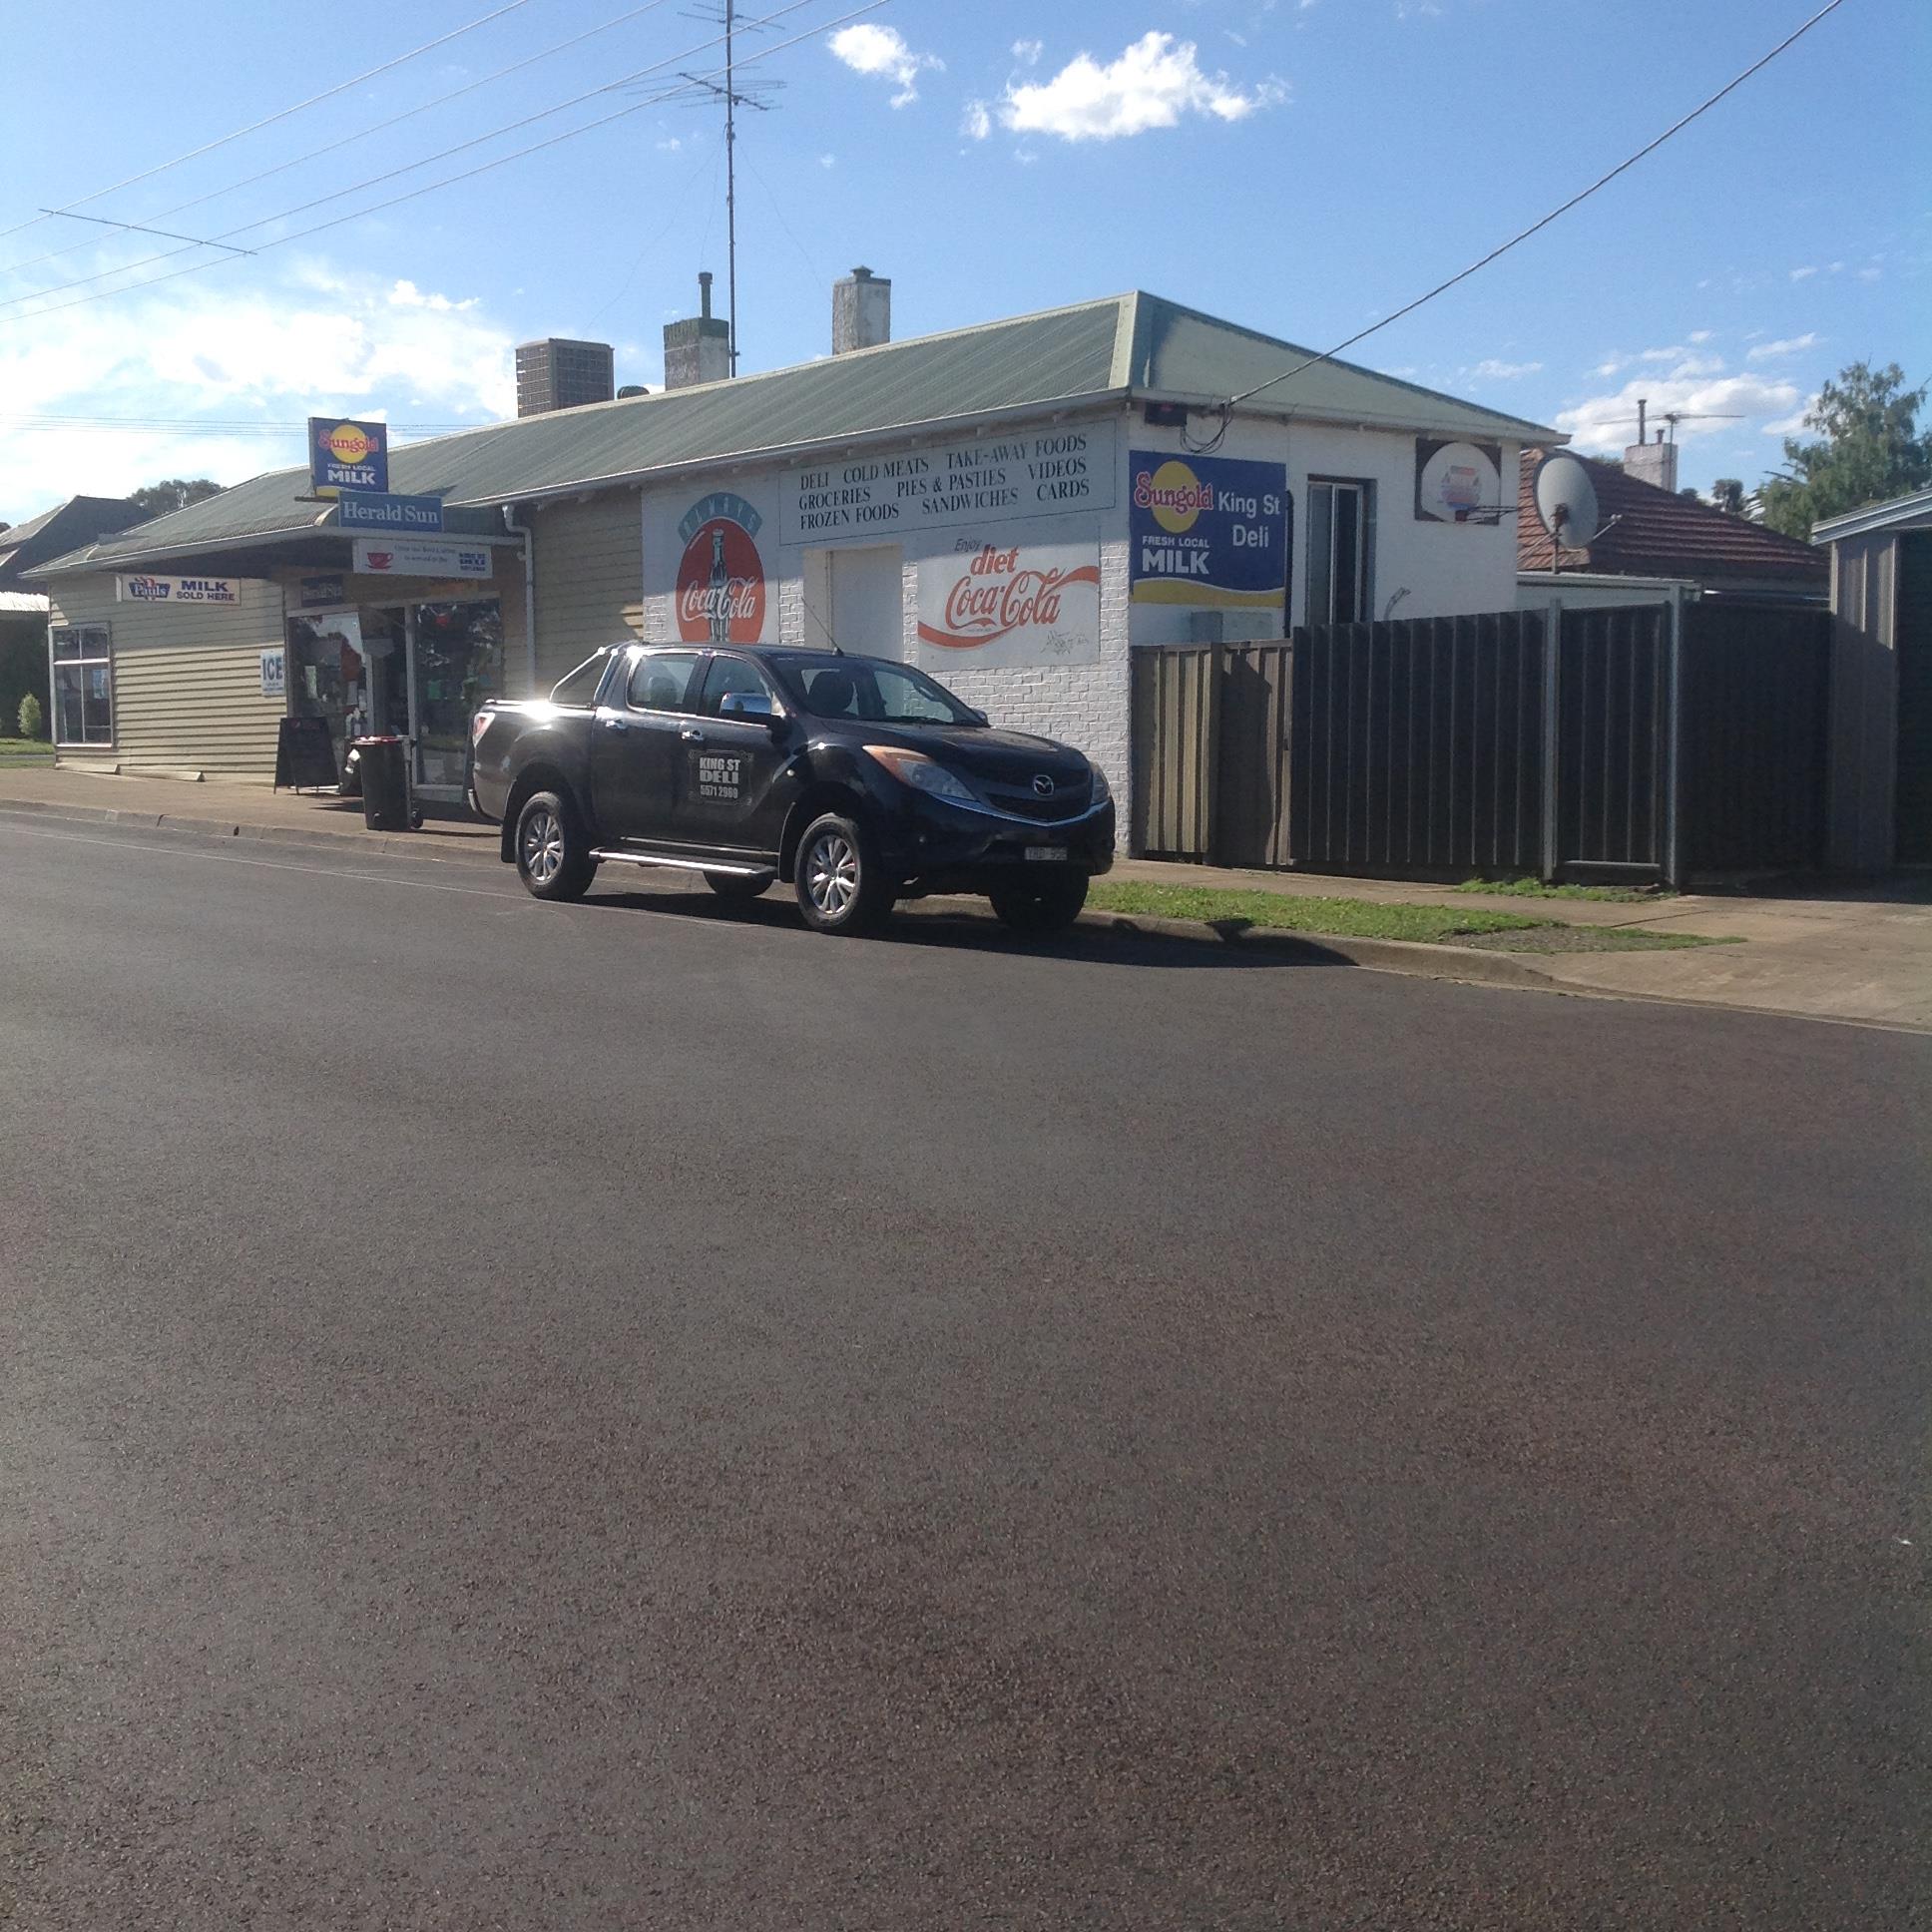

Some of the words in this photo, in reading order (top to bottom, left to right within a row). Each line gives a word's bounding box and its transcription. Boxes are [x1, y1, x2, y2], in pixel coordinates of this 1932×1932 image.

[318, 428, 379, 453] Sungold
[946, 441, 1028, 470] TAKE-AWAY
[1035, 433, 1087, 458] FOODS
[327, 469, 376, 485] MILK
[799, 471, 830, 490] DELI
[842, 464, 879, 484] COLD
[882, 457, 929, 479] MEATS
[1028, 456, 1087, 480] VIDEOS
[897, 478, 927, 498] PIES
[932, 476, 943, 493] &
[949, 467, 1006, 491] PASTIES
[1036, 478, 1090, 502] CARDS
[1134, 471, 1214, 516] Sungold
[798, 486, 871, 511] GROCERIES
[921, 487, 1019, 516] SANDWICHES
[1218, 491, 1257, 519] King
[1262, 494, 1281, 516] St
[342, 501, 401, 522] Herald
[404, 505, 439, 524] Sun
[799, 509, 850, 530] FROZEN
[855, 503, 900, 524] FOODS
[1142, 535, 1176, 546] FRESH
[1179, 537, 1210, 548] LOCAL
[1232, 524, 1269, 548] Deli
[970, 544, 1019, 576] diet
[1142, 548, 1210, 575] MILK
[176, 591, 204, 600] SOLD
[207, 592, 236, 601] HERE
[181, 580, 229, 592] MILK
[262, 657, 283, 681] ICE
[700, 757, 725, 770] KING
[726, 758, 741, 771] ST
[700, 769, 739, 784] DELI
